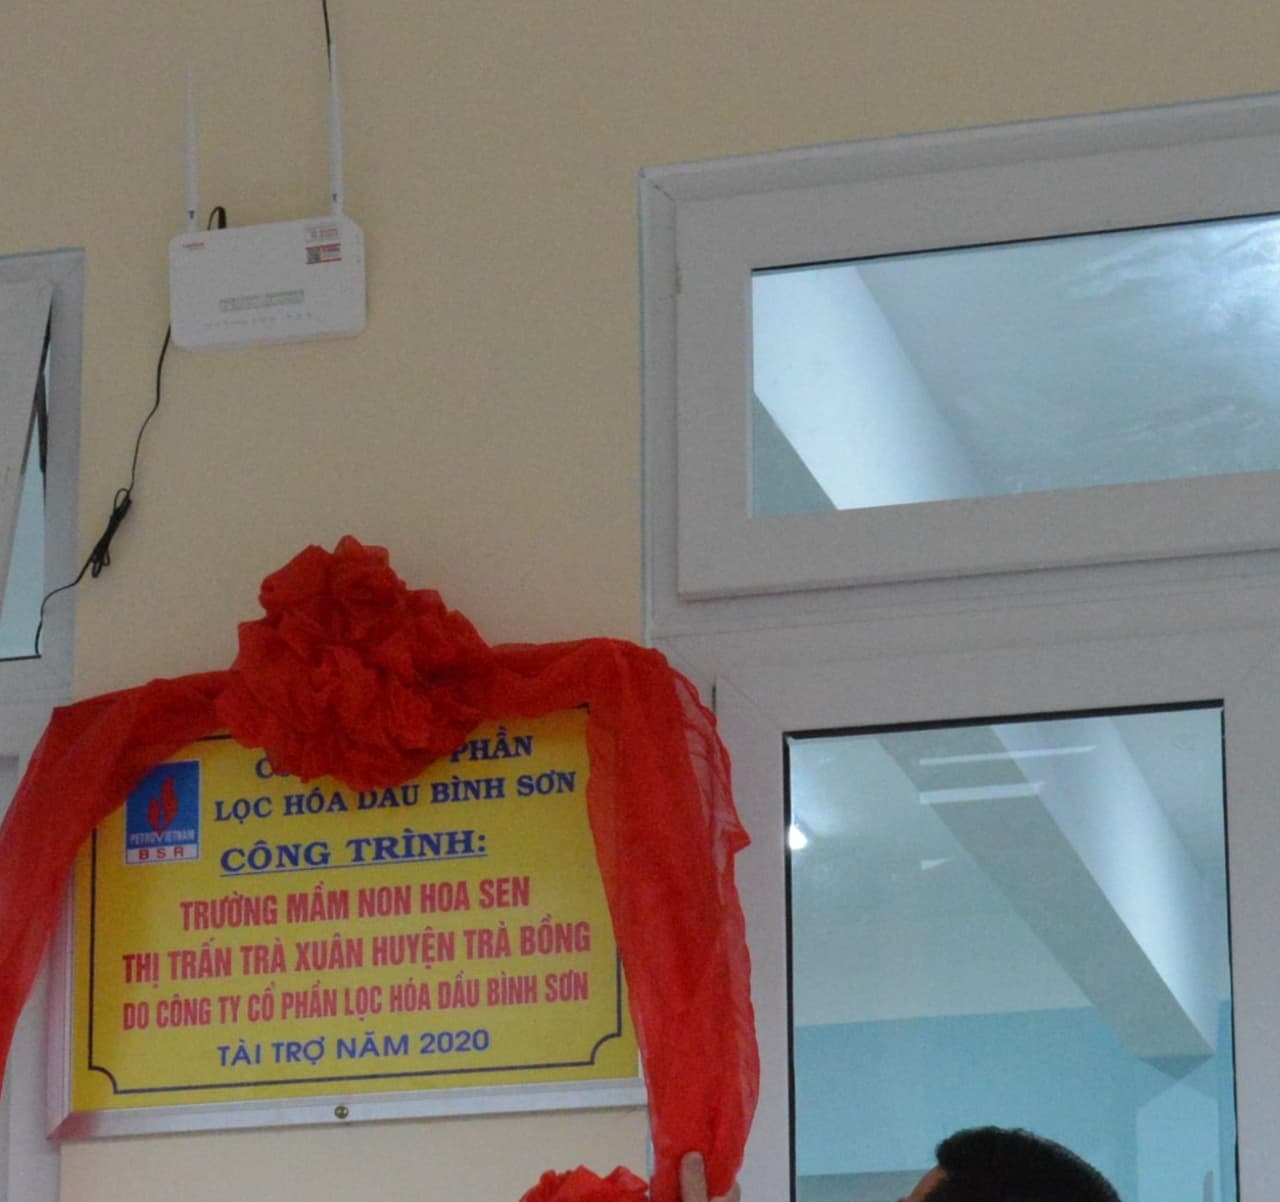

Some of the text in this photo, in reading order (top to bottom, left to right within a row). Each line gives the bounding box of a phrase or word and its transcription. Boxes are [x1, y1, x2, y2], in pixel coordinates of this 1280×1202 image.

[214, 796, 273, 825] LỌC
[283, 788, 348, 817] HÓA
[431, 772, 506, 805] BÌNH
[516, 768, 577, 798] SƠN
[220, 828, 488, 874] CÔNG TRÌNH:
[180, 890, 278, 931] TRƯỜNG
[358, 885, 412, 918] NON
[420, 880, 471, 914] HOA
[479, 875, 531, 909] SEN
[122, 913, 591, 988] THỊ TRẤN TRÀ XUÂN HUYỆN TRÀ BỒNG
[122, 1001, 150, 1030] DO
[156, 993, 212, 1029] CÔNG
[218, 995, 241, 1025] TY
[344, 985, 383, 1022] LỌC
[389, 976, 431, 1013] HÓA
[487, 970, 539, 1007] BÌNH
[545, 968, 589, 1003] SƠN
[217, 1028, 490, 1067] TÀI TRỢ NĂM 2020
